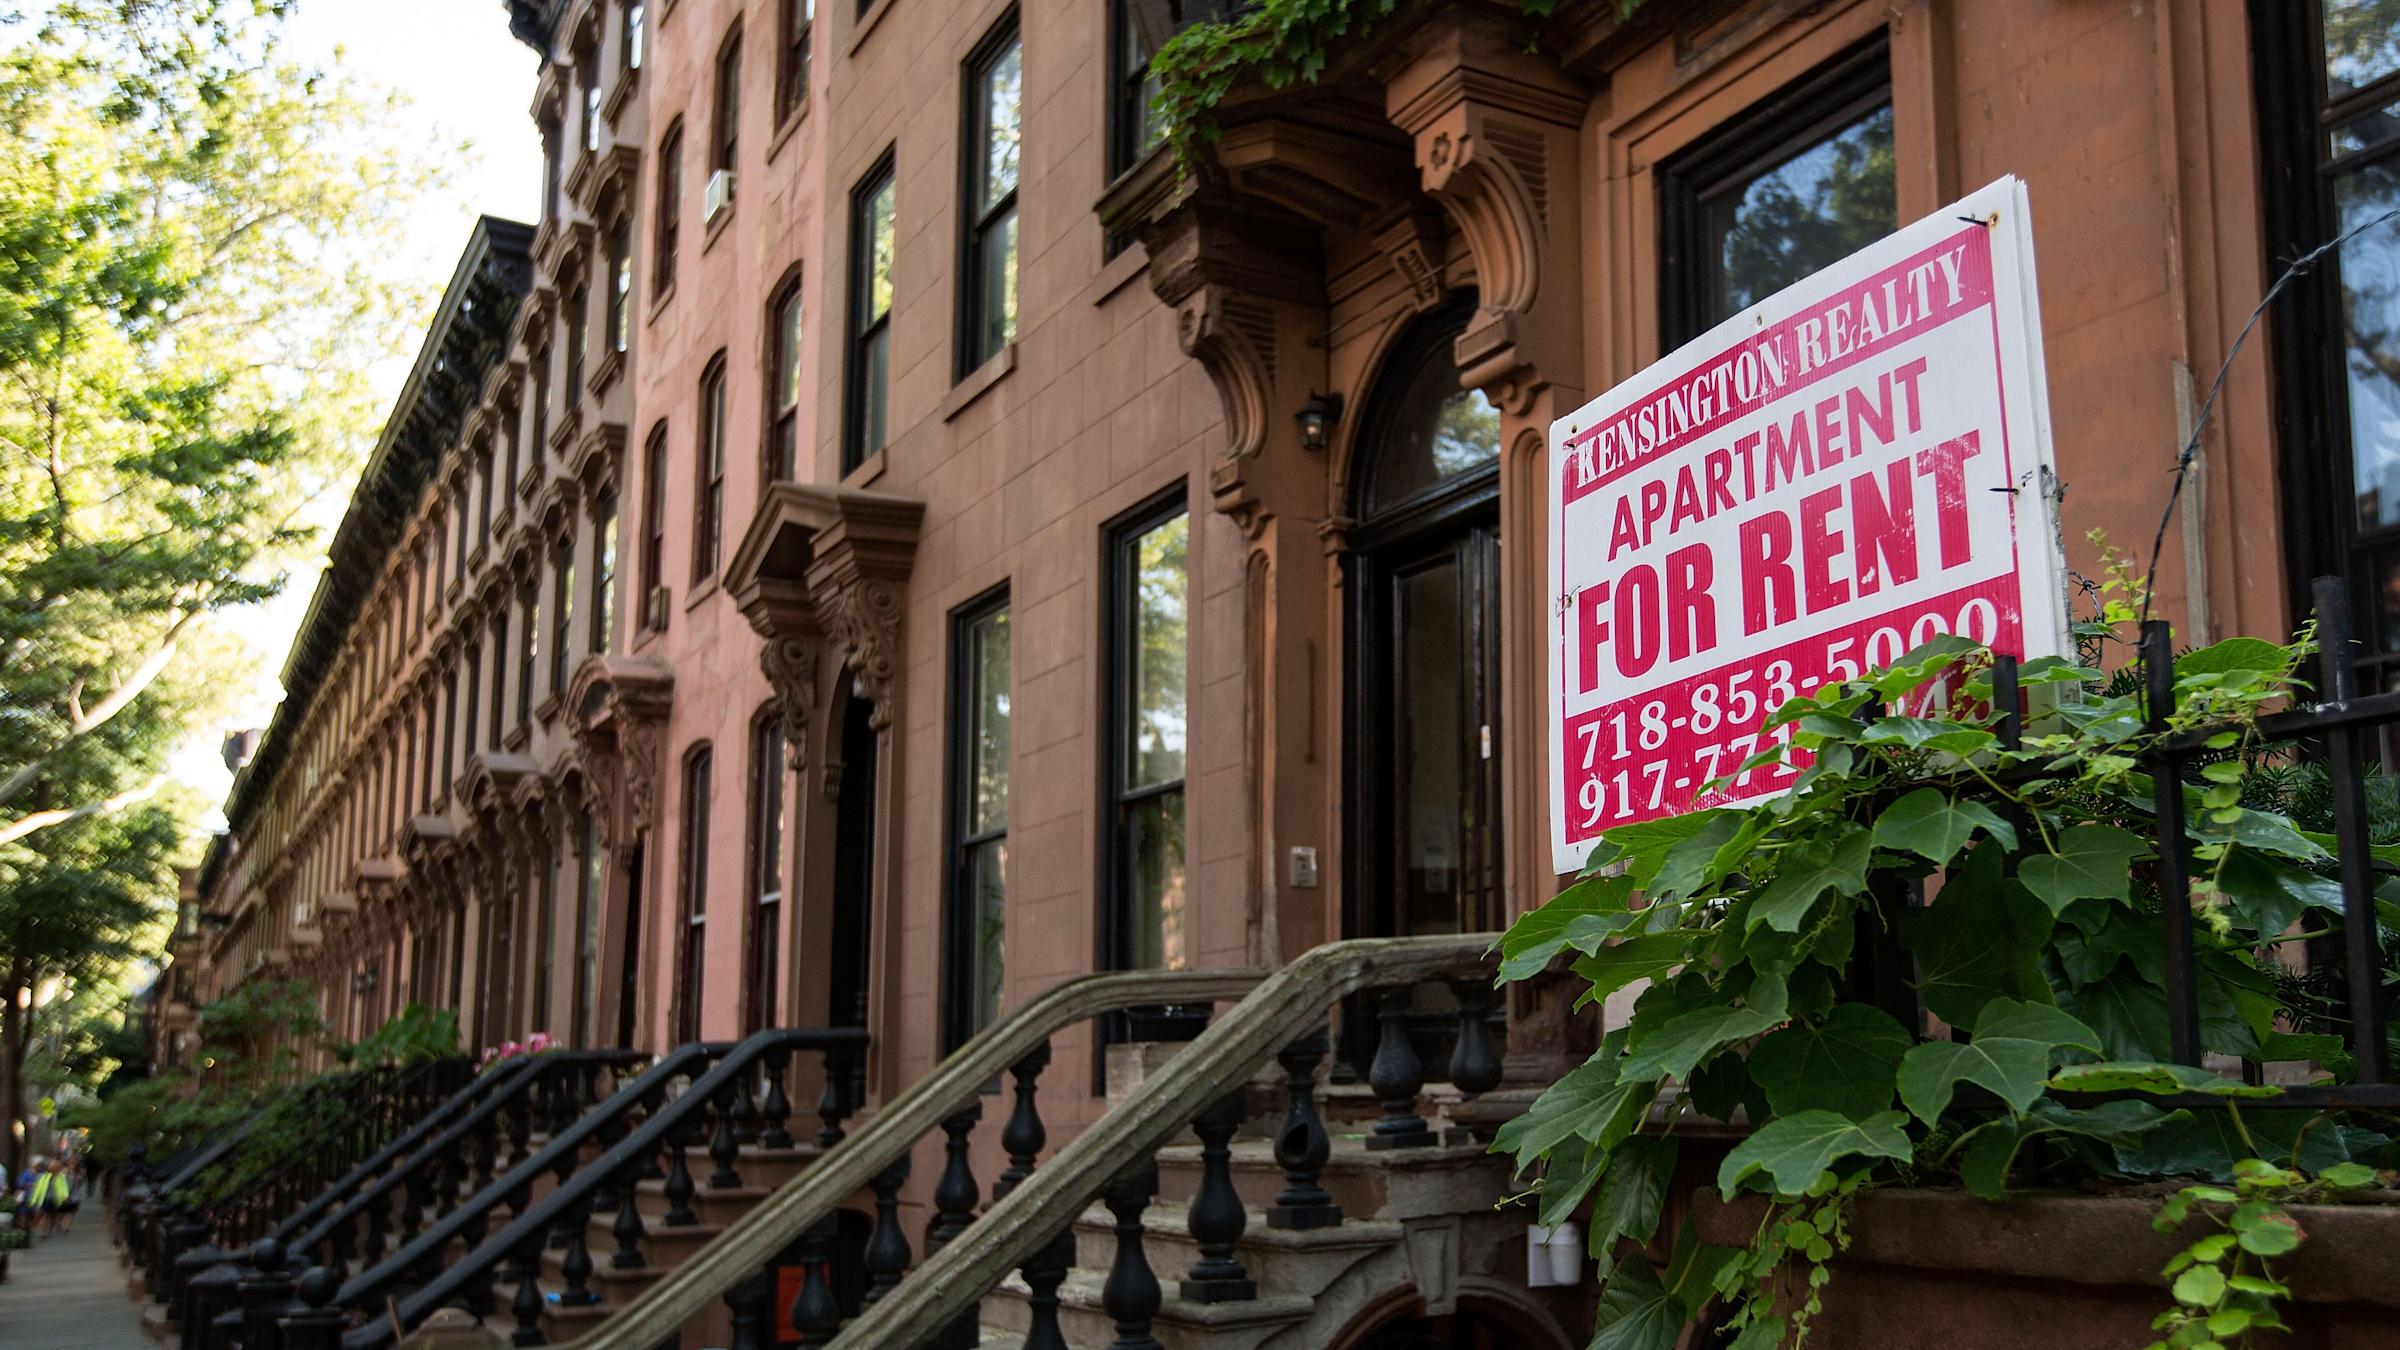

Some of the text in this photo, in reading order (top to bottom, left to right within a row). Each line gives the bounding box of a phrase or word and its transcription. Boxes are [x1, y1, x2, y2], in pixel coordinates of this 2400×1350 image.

[1576, 244, 1967, 489] KENSINGTON REALTY
[1607, 356, 1927, 562] APARTMENT
[1578, 429, 1981, 695] FOR RENT
